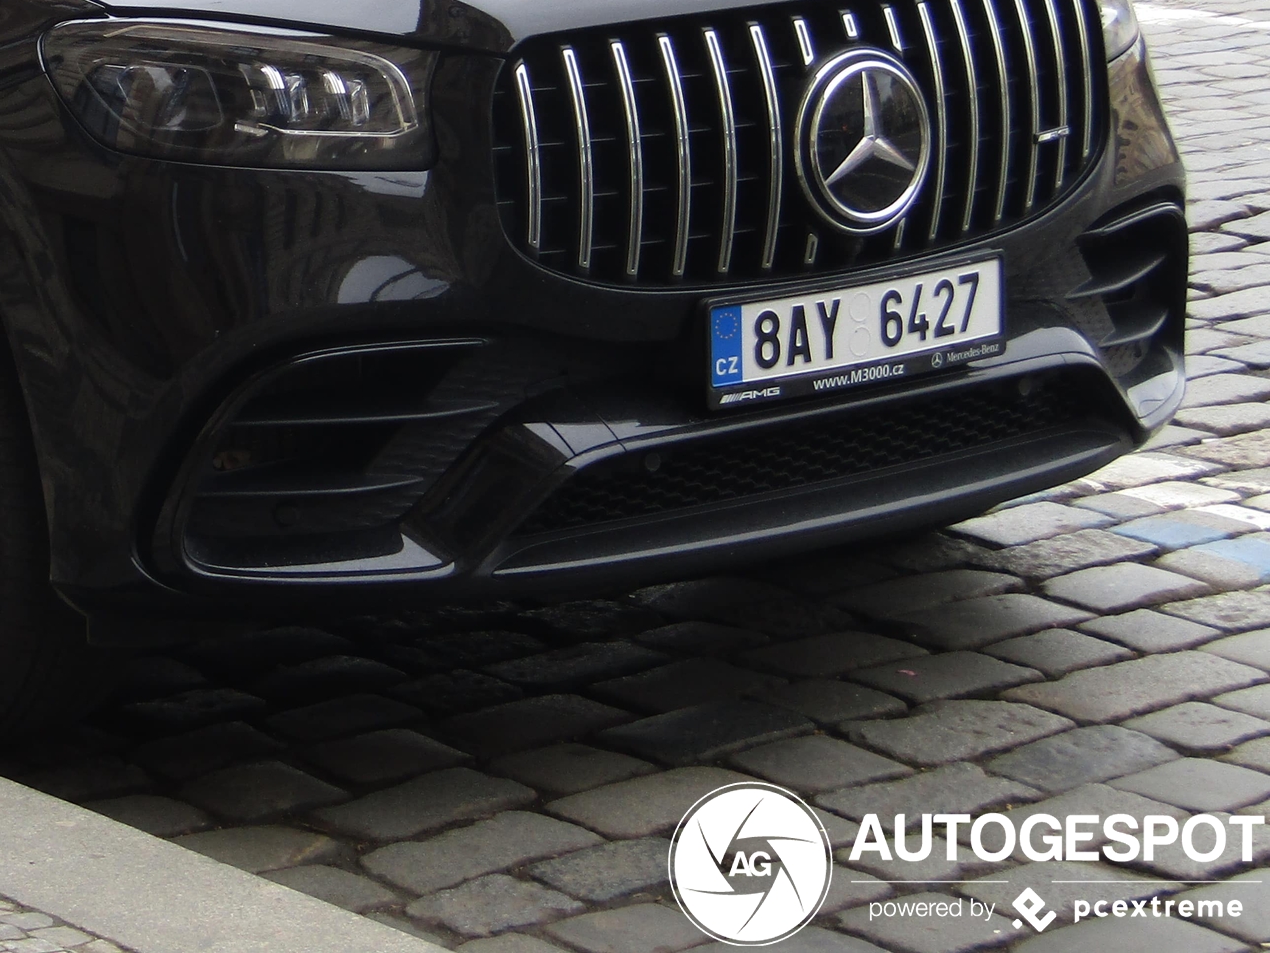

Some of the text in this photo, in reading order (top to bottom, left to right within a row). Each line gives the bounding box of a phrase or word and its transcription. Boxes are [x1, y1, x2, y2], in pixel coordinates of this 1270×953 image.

[754, 271, 980, 369] 8AY 6427
[715, 356, 739, 376] CZ
[946, 343, 1000, 364] Mercedes-Benz
[813, 362, 905, 391] www.M3000.cz
